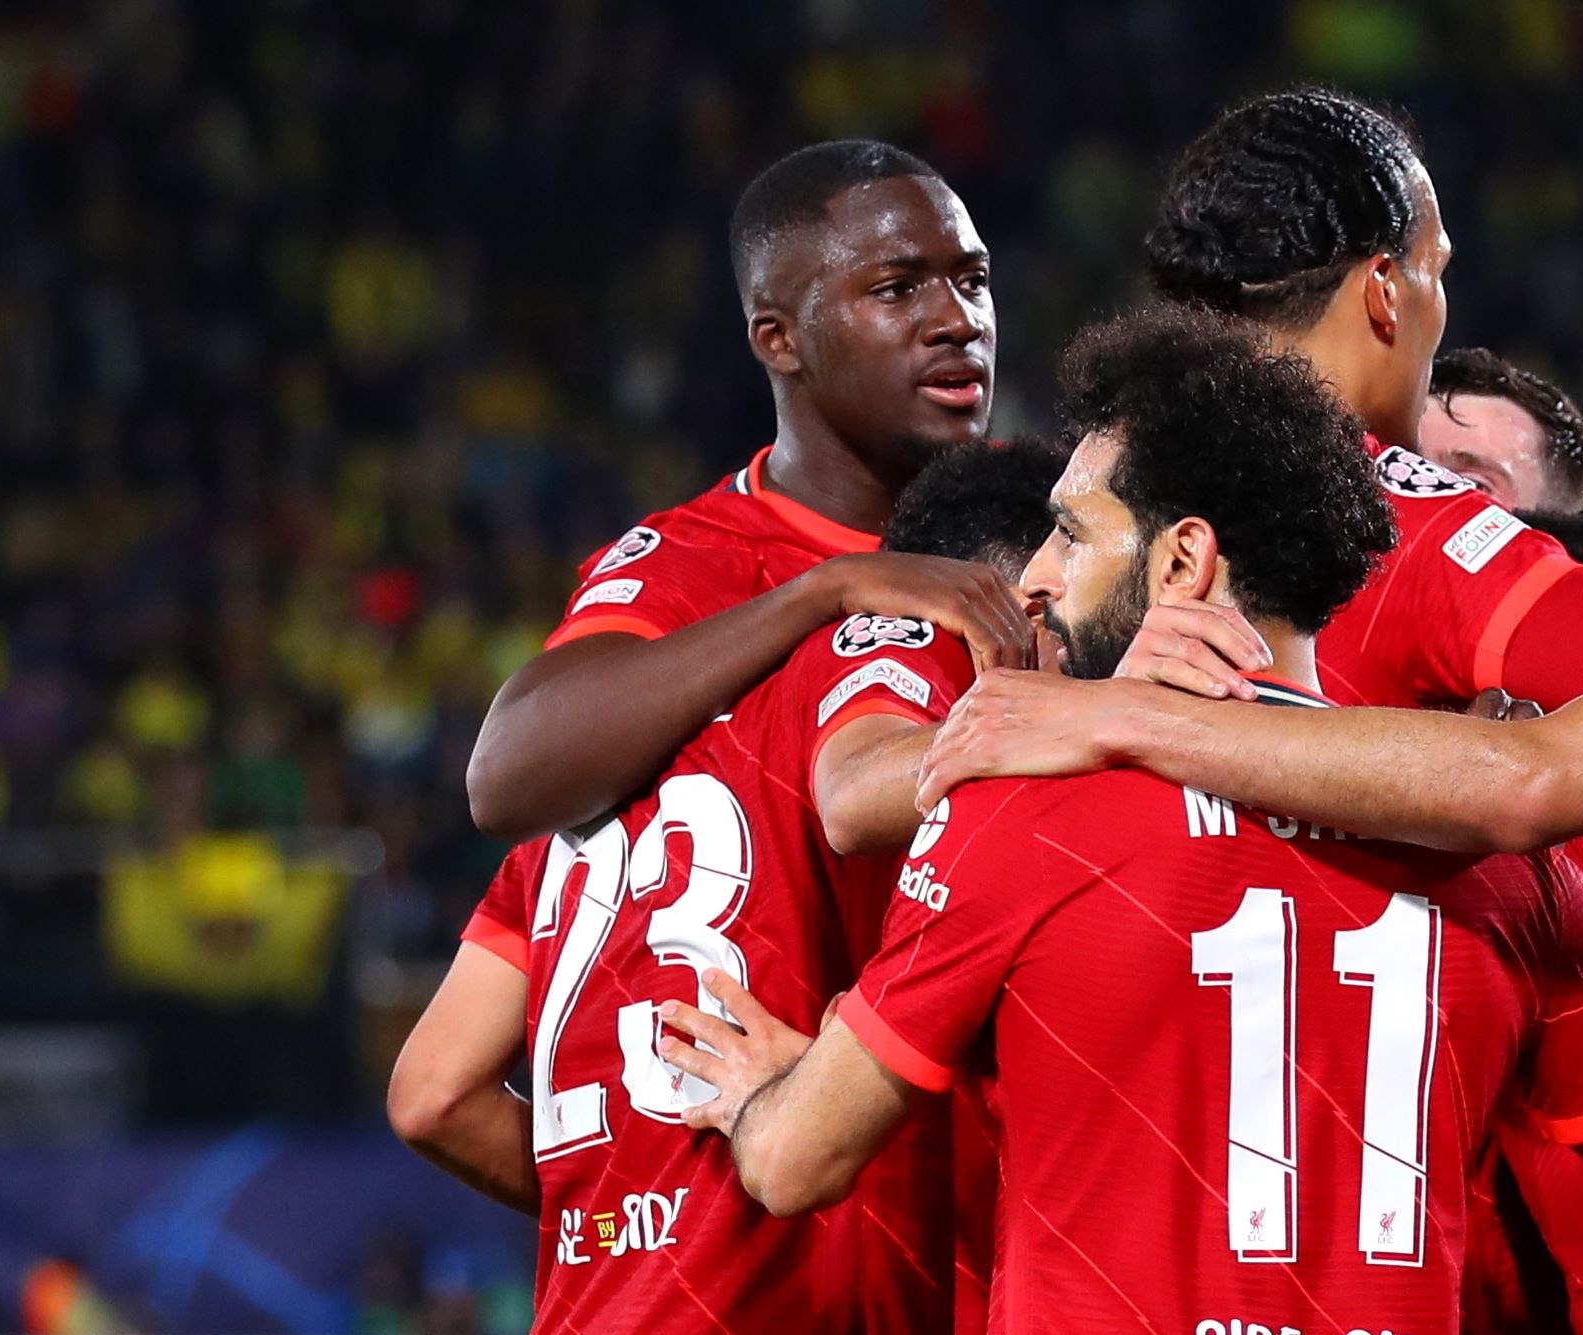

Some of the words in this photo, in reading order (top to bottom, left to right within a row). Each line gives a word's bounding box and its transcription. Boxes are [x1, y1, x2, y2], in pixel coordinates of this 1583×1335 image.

[531, 773, 753, 1164] 23
[1191, 887, 1441, 1266] 11
[596, 1217, 617, 1241] BY
